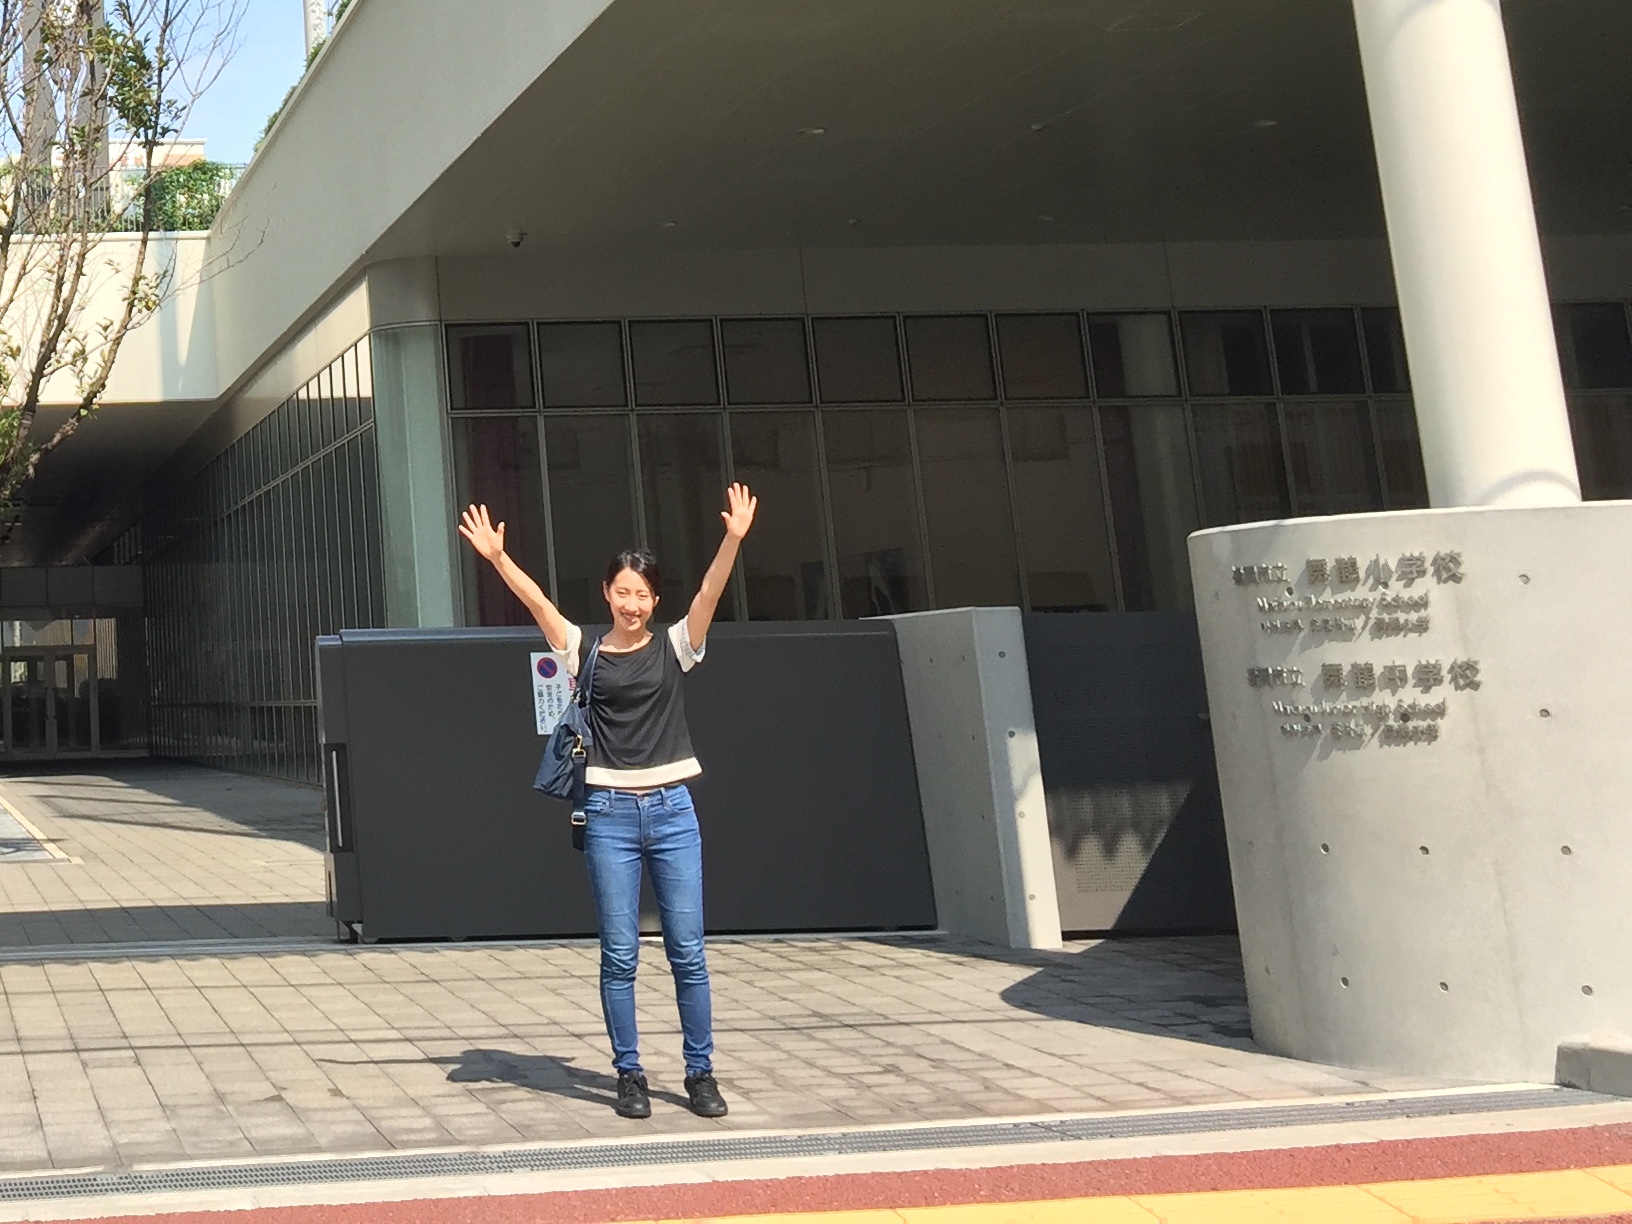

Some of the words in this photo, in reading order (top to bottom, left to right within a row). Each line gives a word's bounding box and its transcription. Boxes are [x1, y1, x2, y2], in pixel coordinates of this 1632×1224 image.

[1306, 549, 1465, 588] 舞鶴小学校
[1377, 590, 1431, 611] School
[1321, 658, 1484, 693] 舞鶴中学校
